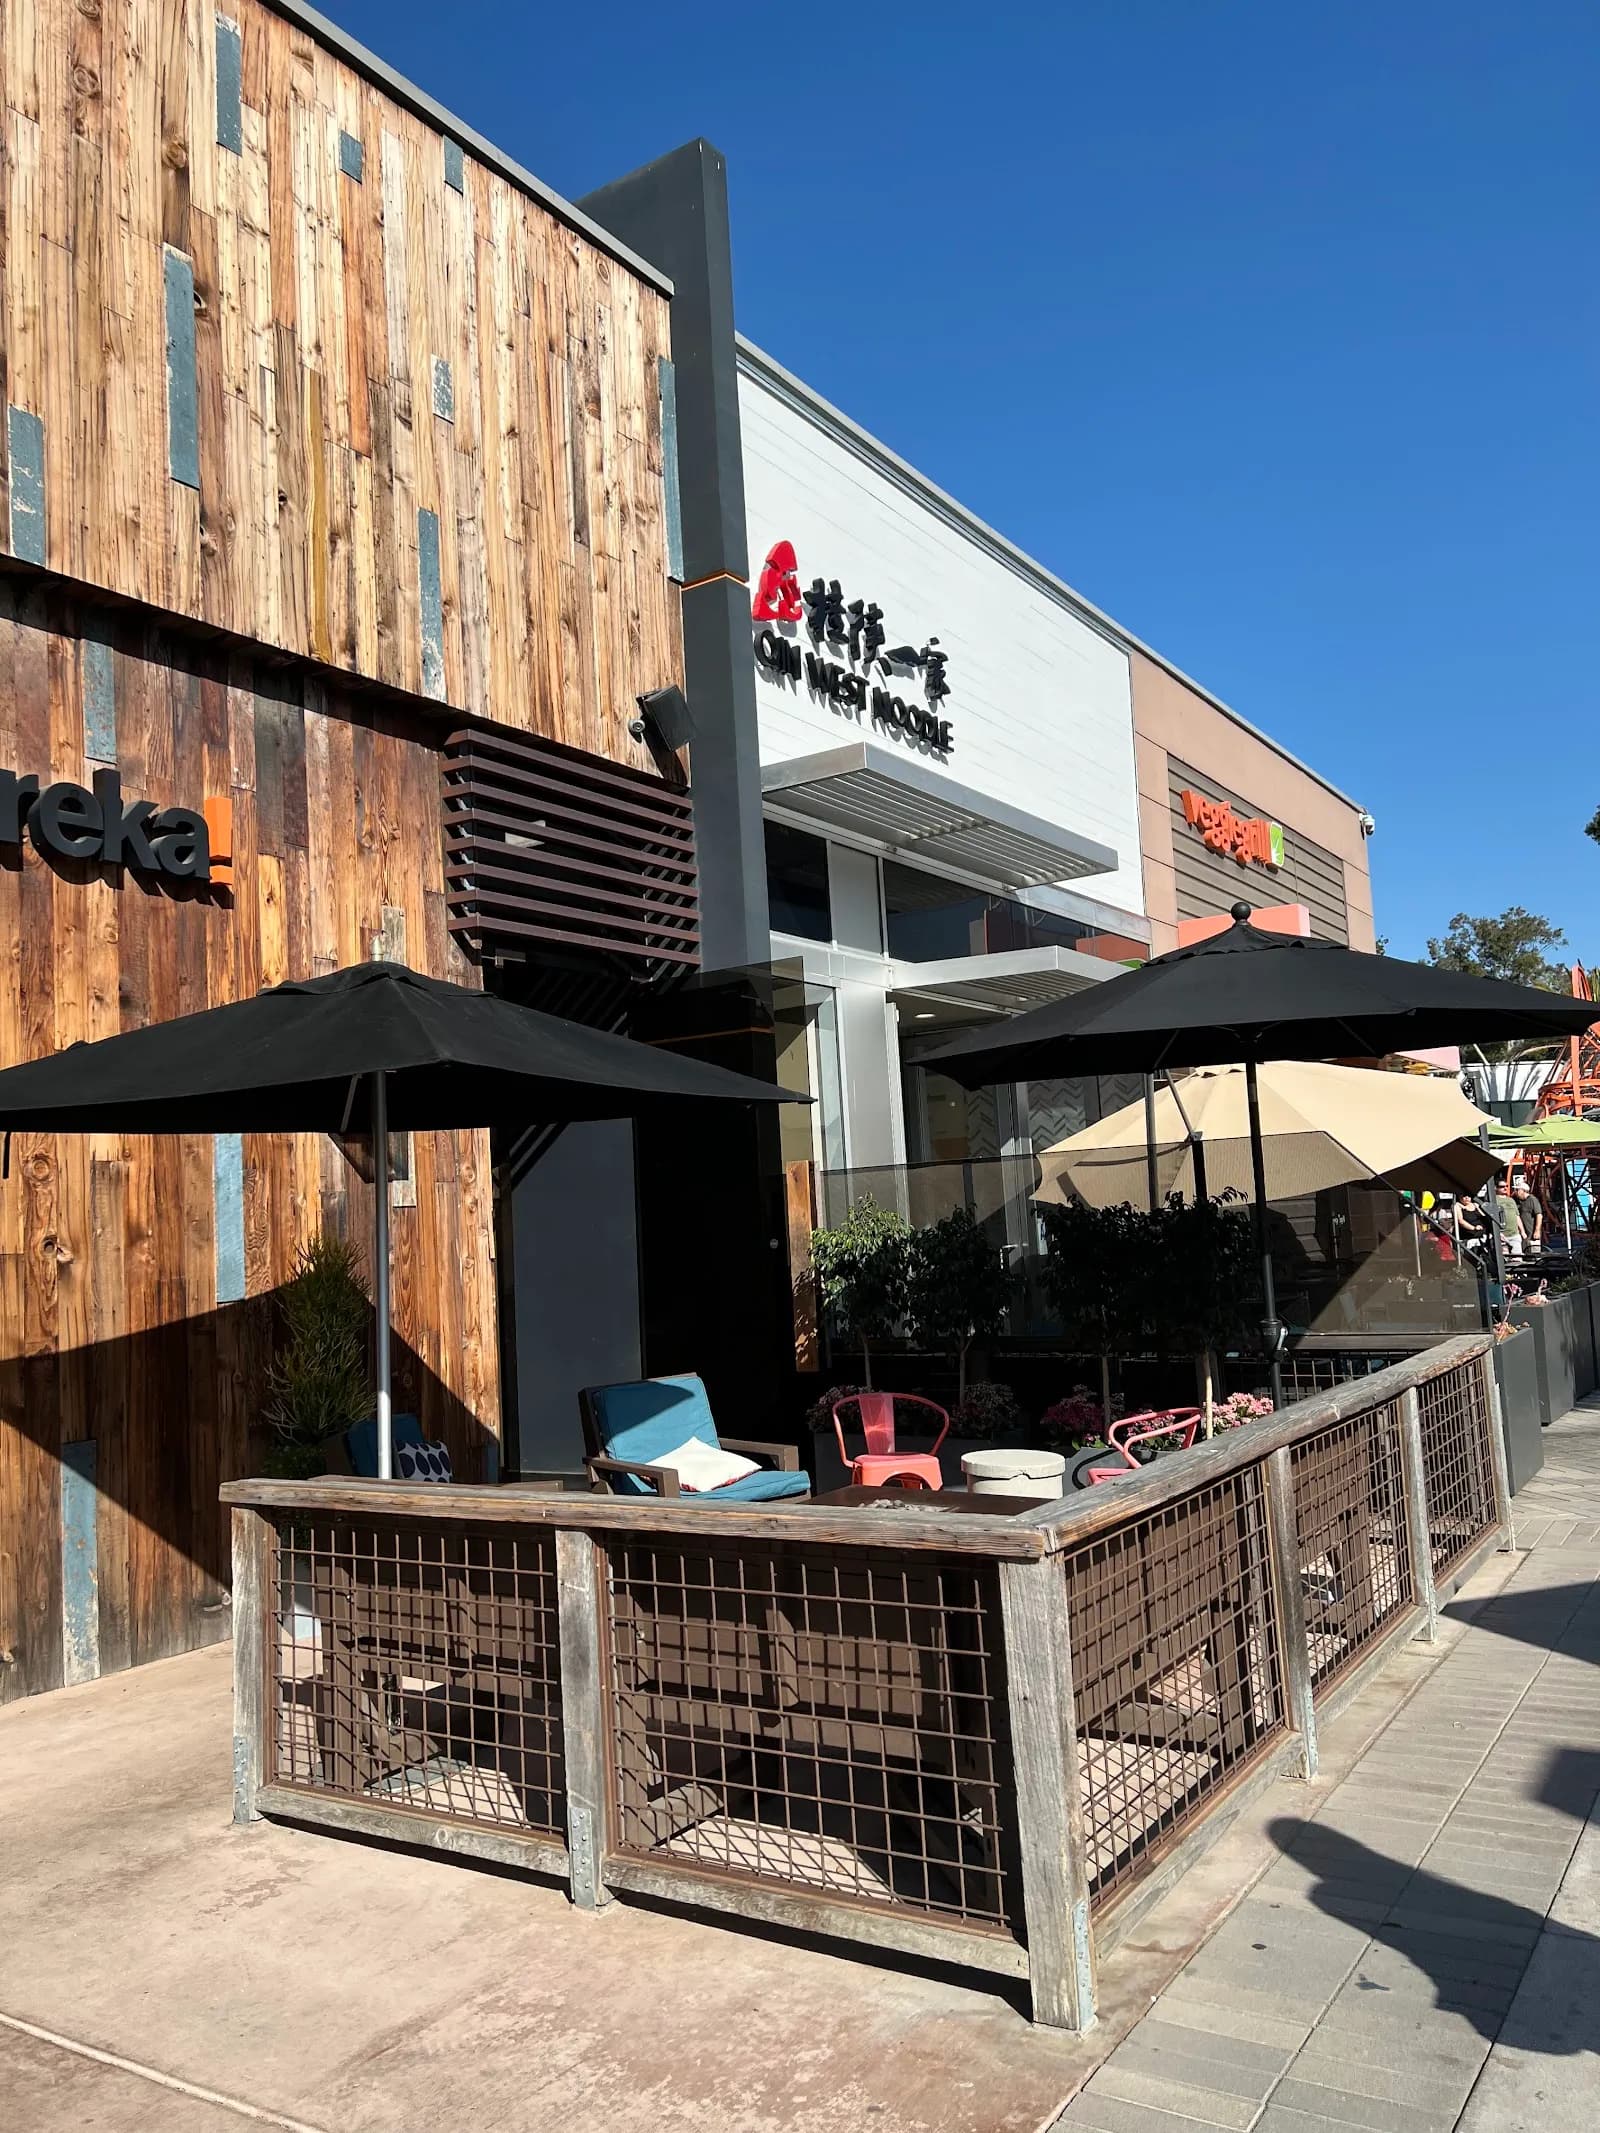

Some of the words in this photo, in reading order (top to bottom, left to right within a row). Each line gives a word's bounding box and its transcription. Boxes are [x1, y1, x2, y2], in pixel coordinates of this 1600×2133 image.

[754, 629, 801, 680] QIN
[805, 652, 869, 711] WEST
[872, 687, 954, 753] NOODLE
